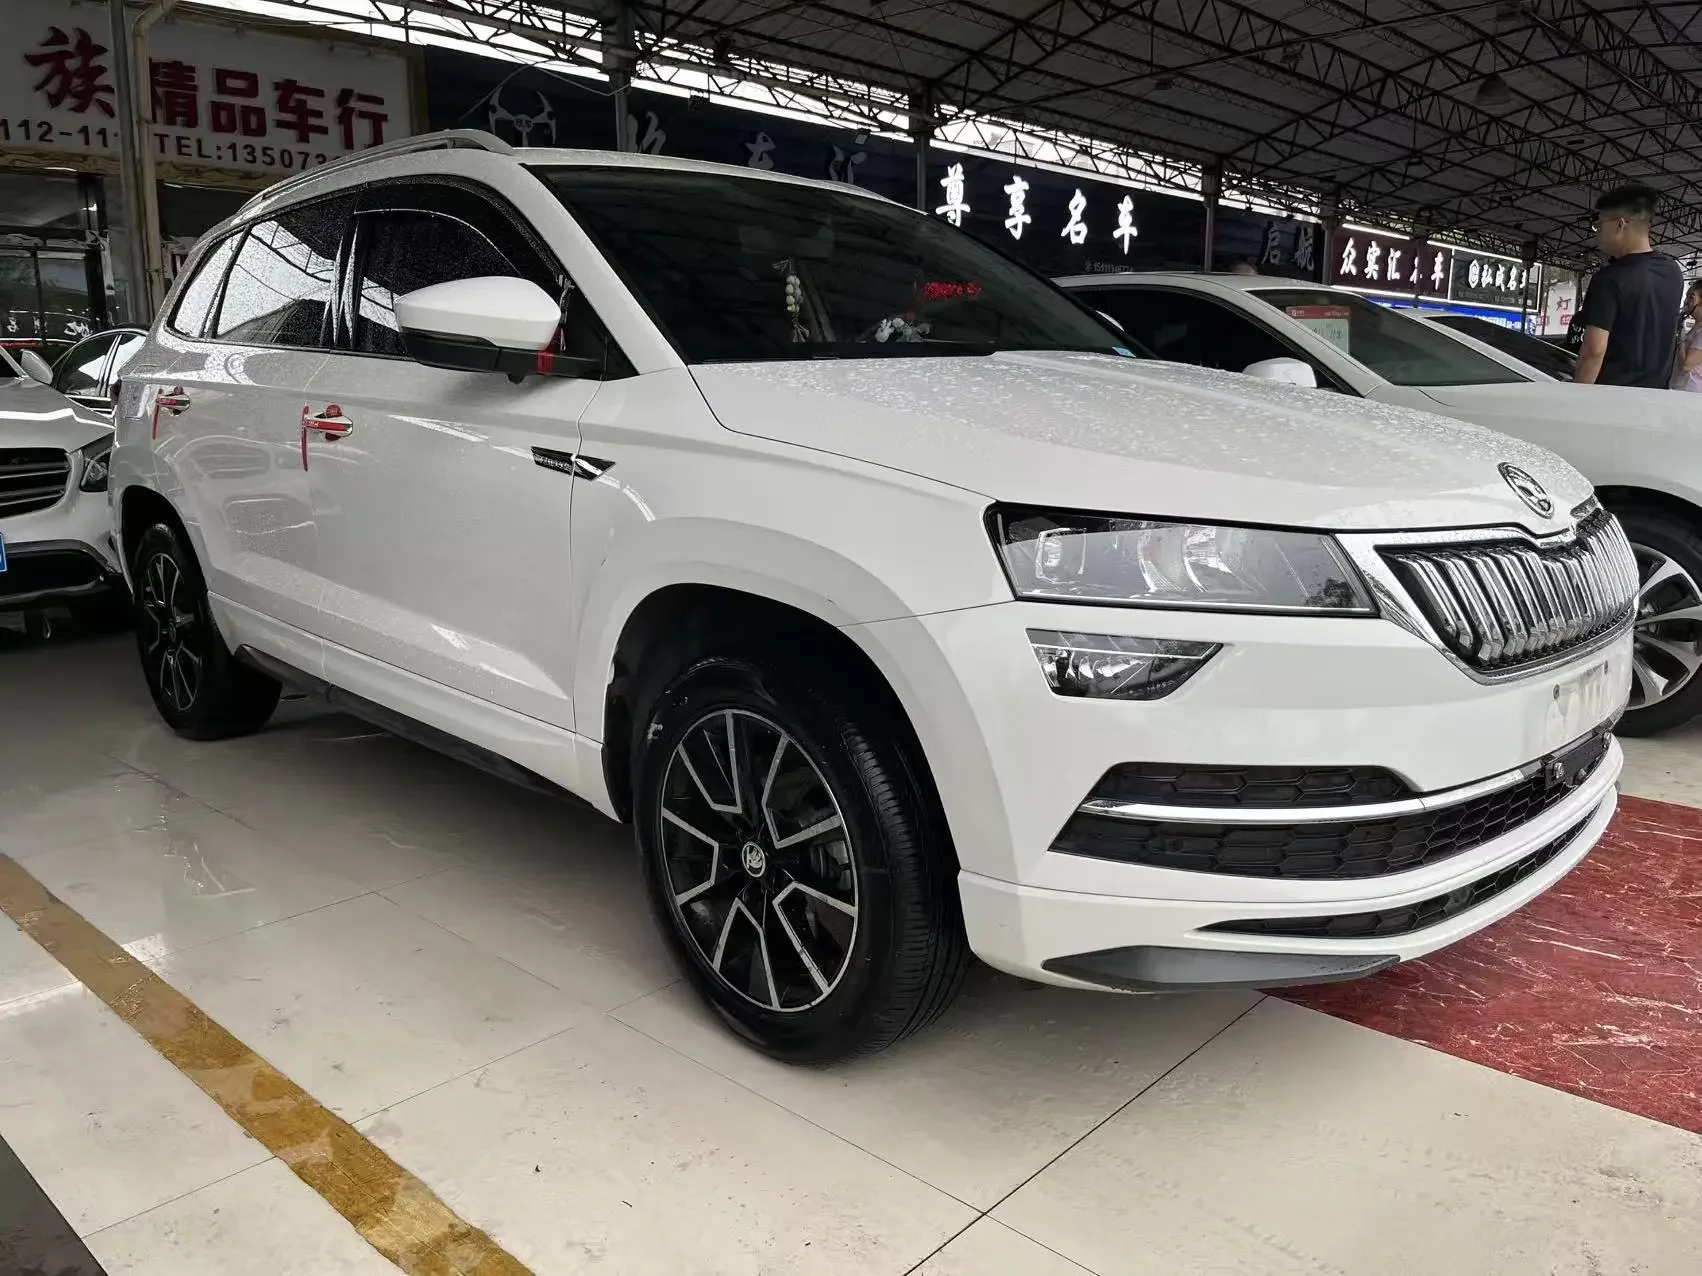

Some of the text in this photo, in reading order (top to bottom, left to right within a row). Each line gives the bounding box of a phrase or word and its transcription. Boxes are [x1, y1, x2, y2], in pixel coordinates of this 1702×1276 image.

[154, 132, 341, 170] TEL:135073
[935, 162, 1139, 255] 尊享名车
